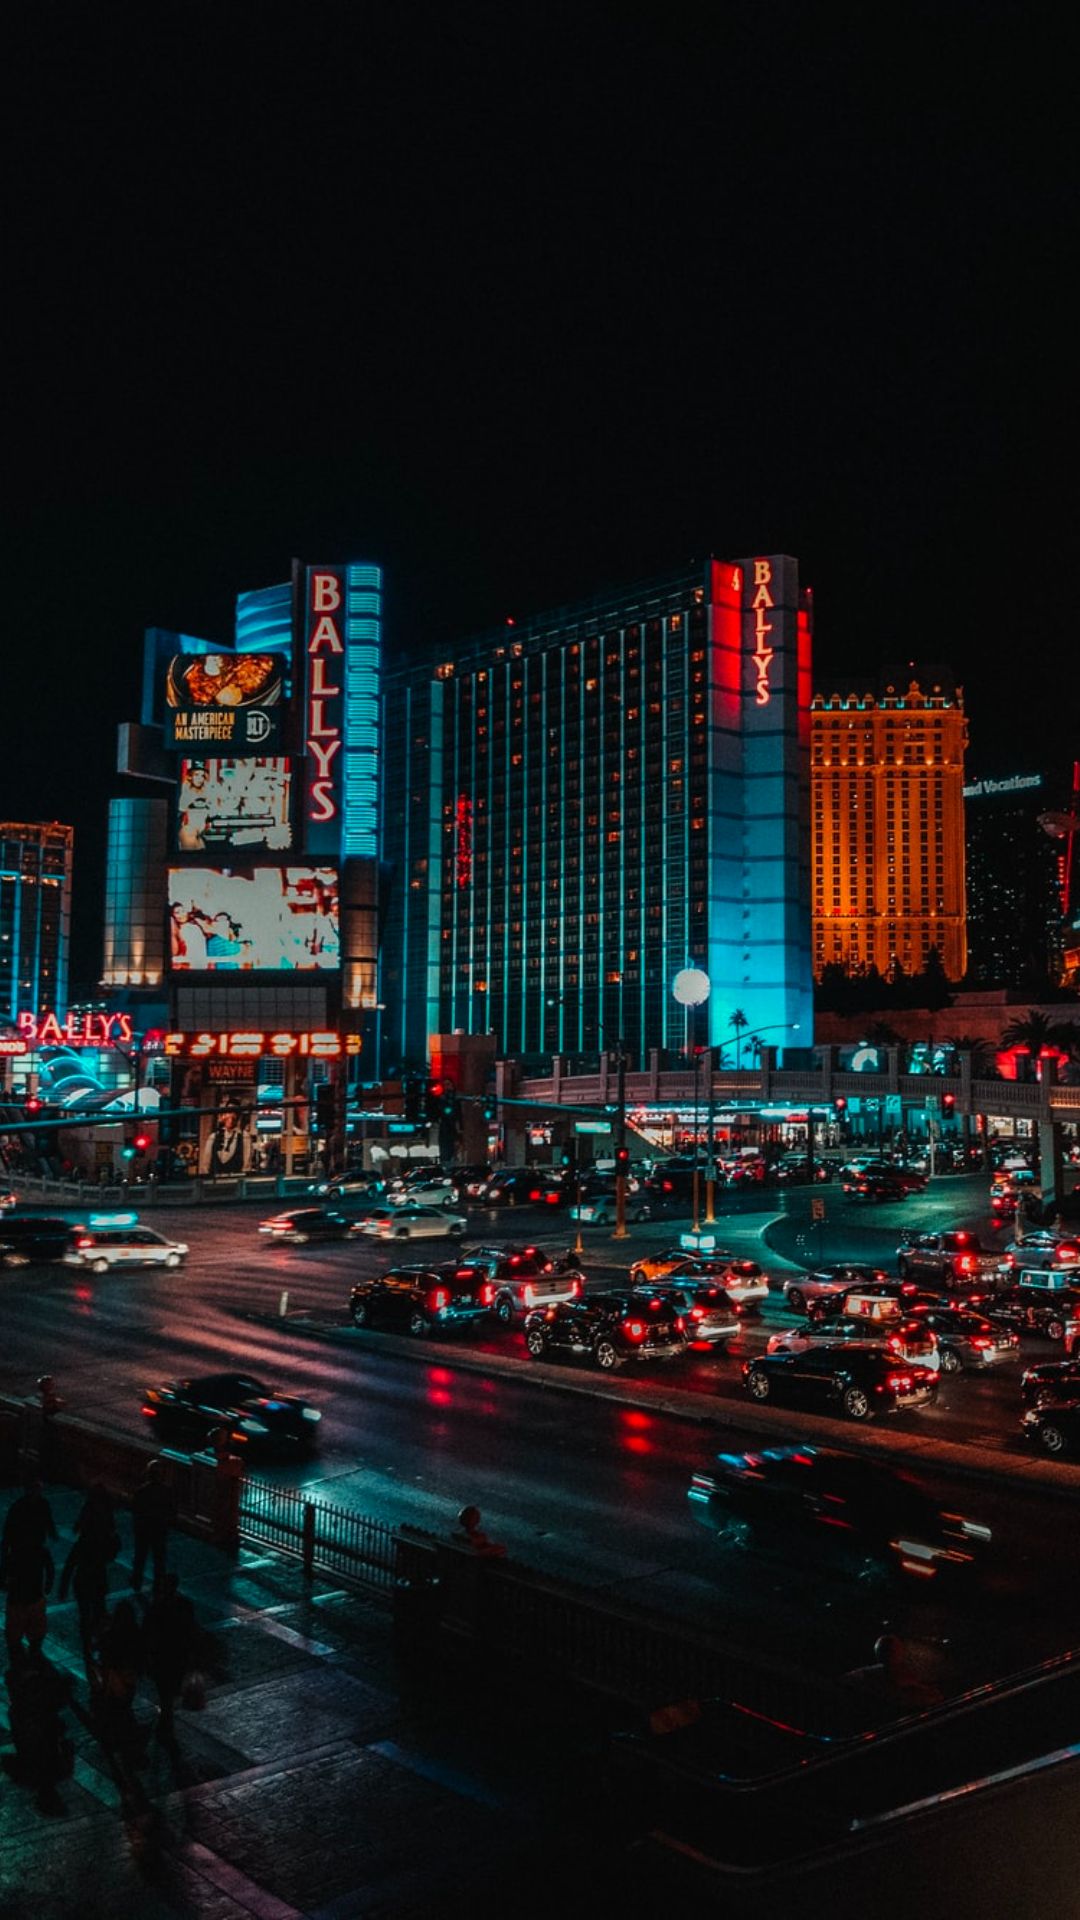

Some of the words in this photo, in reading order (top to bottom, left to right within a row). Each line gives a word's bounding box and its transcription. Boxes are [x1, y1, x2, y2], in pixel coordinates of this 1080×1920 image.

[752, 561, 774, 705] BALLYS
[308, 575, 344, 821] BALLYS
[175, 712, 188, 725] AN
[190, 712, 235, 725] AMERICAN
[175, 726, 233, 740] MASTERPIECE
[983, 775, 1041, 793] Vacations
[20, 1011, 132, 1042] BALLY'S
[208, 1065, 254, 1078] WAYNE
